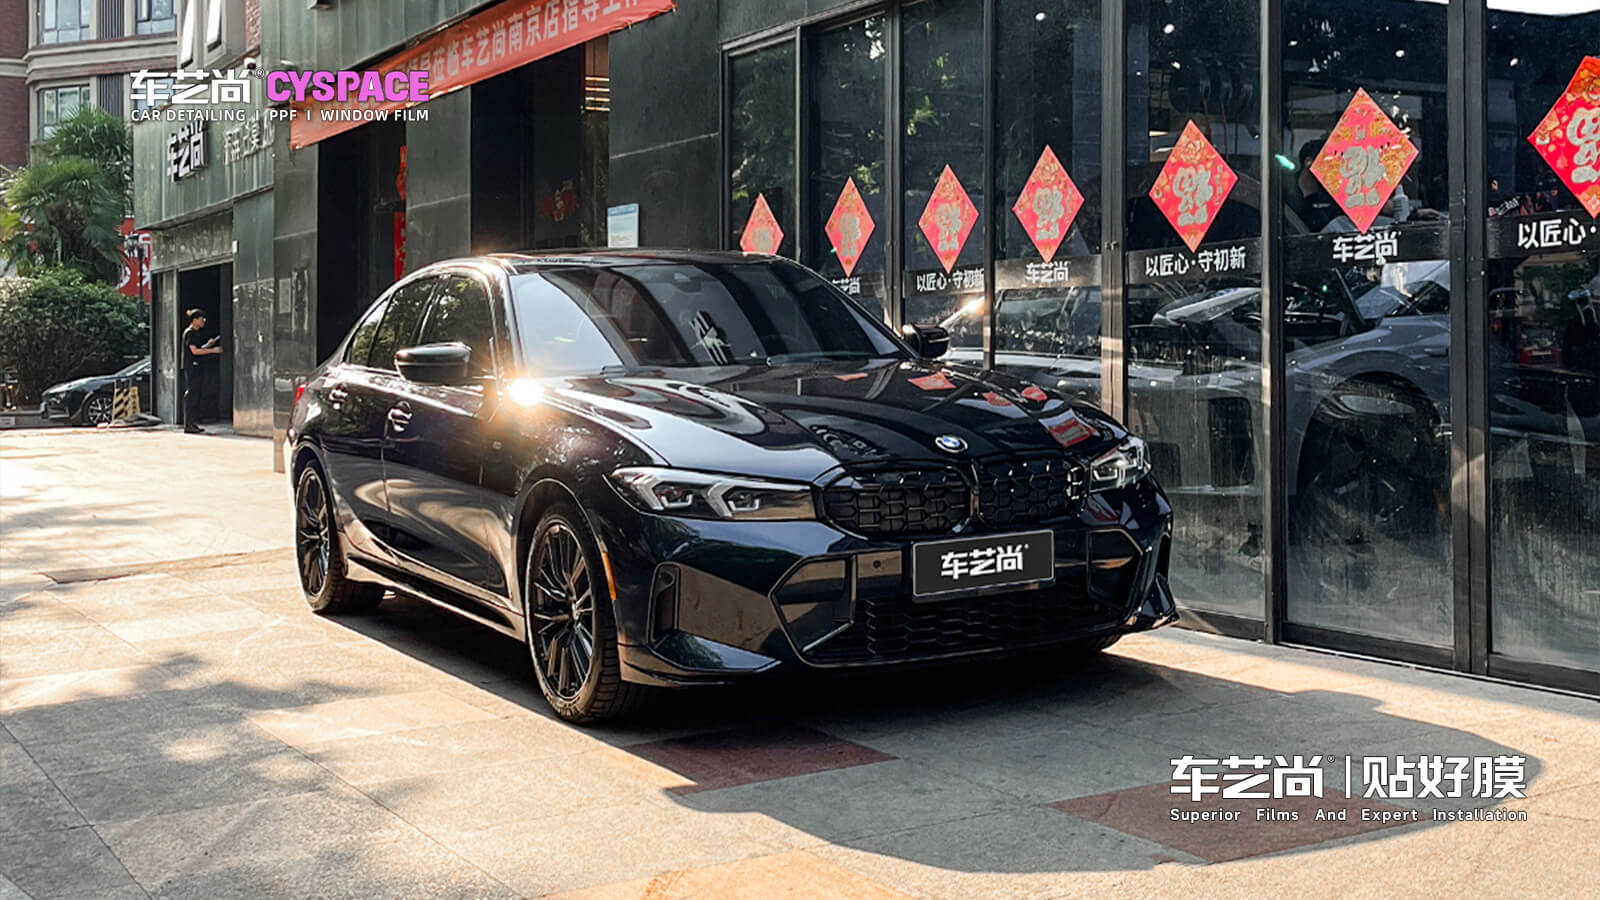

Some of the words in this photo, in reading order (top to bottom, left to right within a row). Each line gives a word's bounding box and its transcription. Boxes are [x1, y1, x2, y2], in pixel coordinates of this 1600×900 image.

[167, 119, 205, 183] 车艺尚
[1332, 231, 1398, 263] 车艺尚
[1025, 260, 1070, 284] 车艺尚
